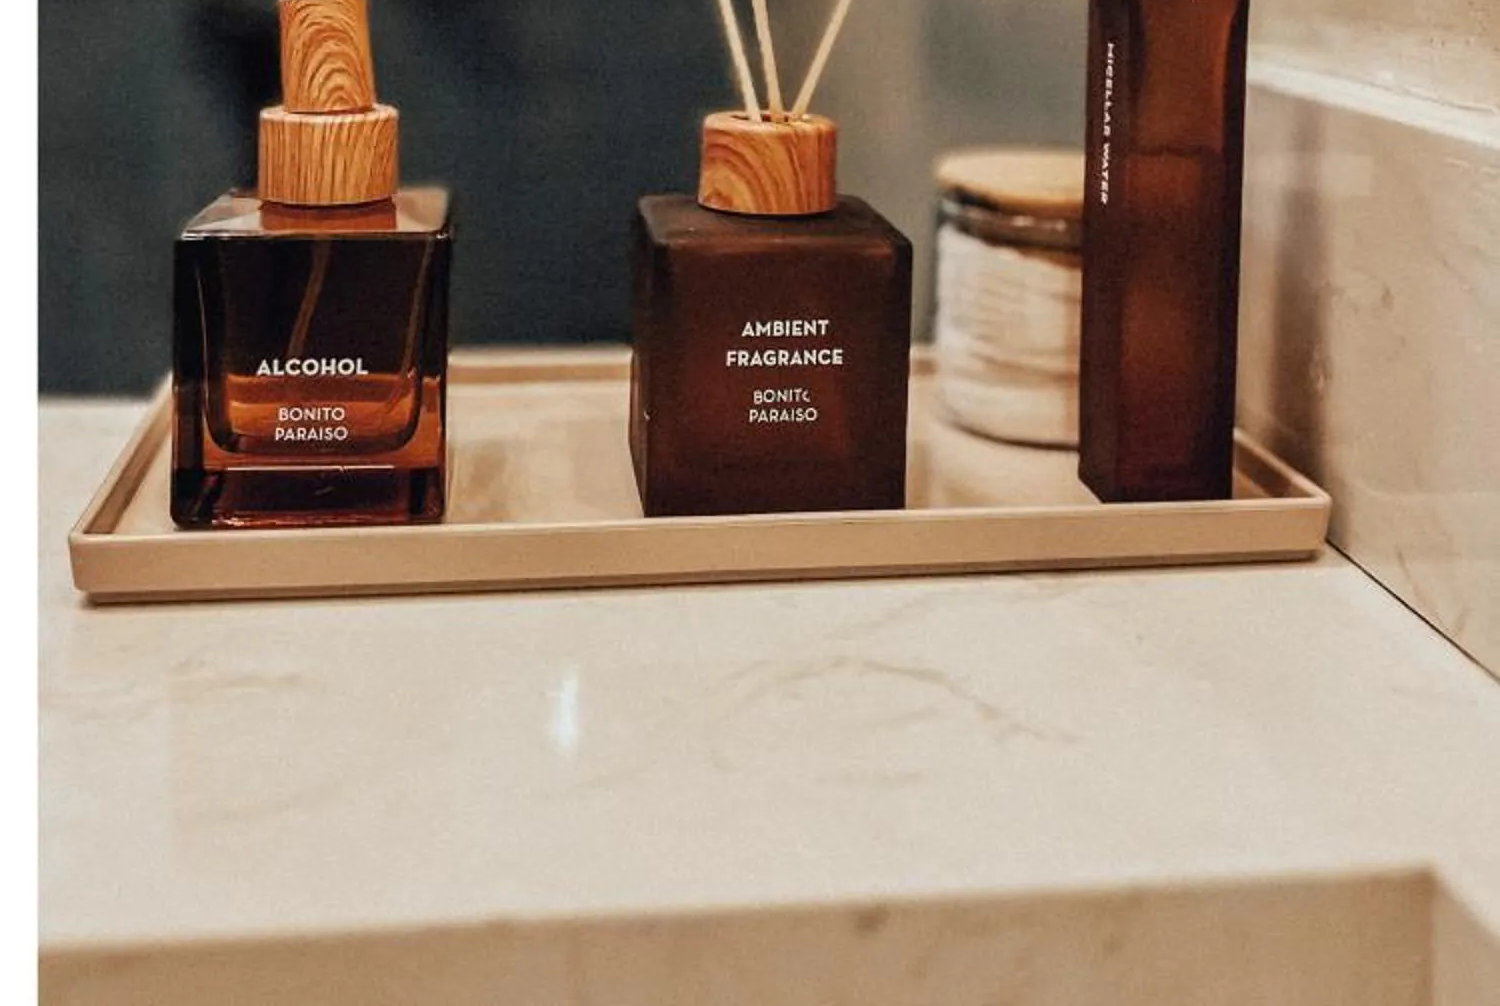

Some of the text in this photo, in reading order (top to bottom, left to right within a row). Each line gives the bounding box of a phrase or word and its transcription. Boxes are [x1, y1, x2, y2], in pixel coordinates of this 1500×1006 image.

[1100, 42, 1114, 204] MICELLAR WATER
[741, 319, 829, 337] AMBIENT
[257, 358, 368, 376] ALCOHOL
[725, 349, 843, 367] FRAGRANCE
[278, 407, 345, 421] BONITO
[749, 407, 818, 423] PARAISO
[275, 427, 348, 441] PARAISO
